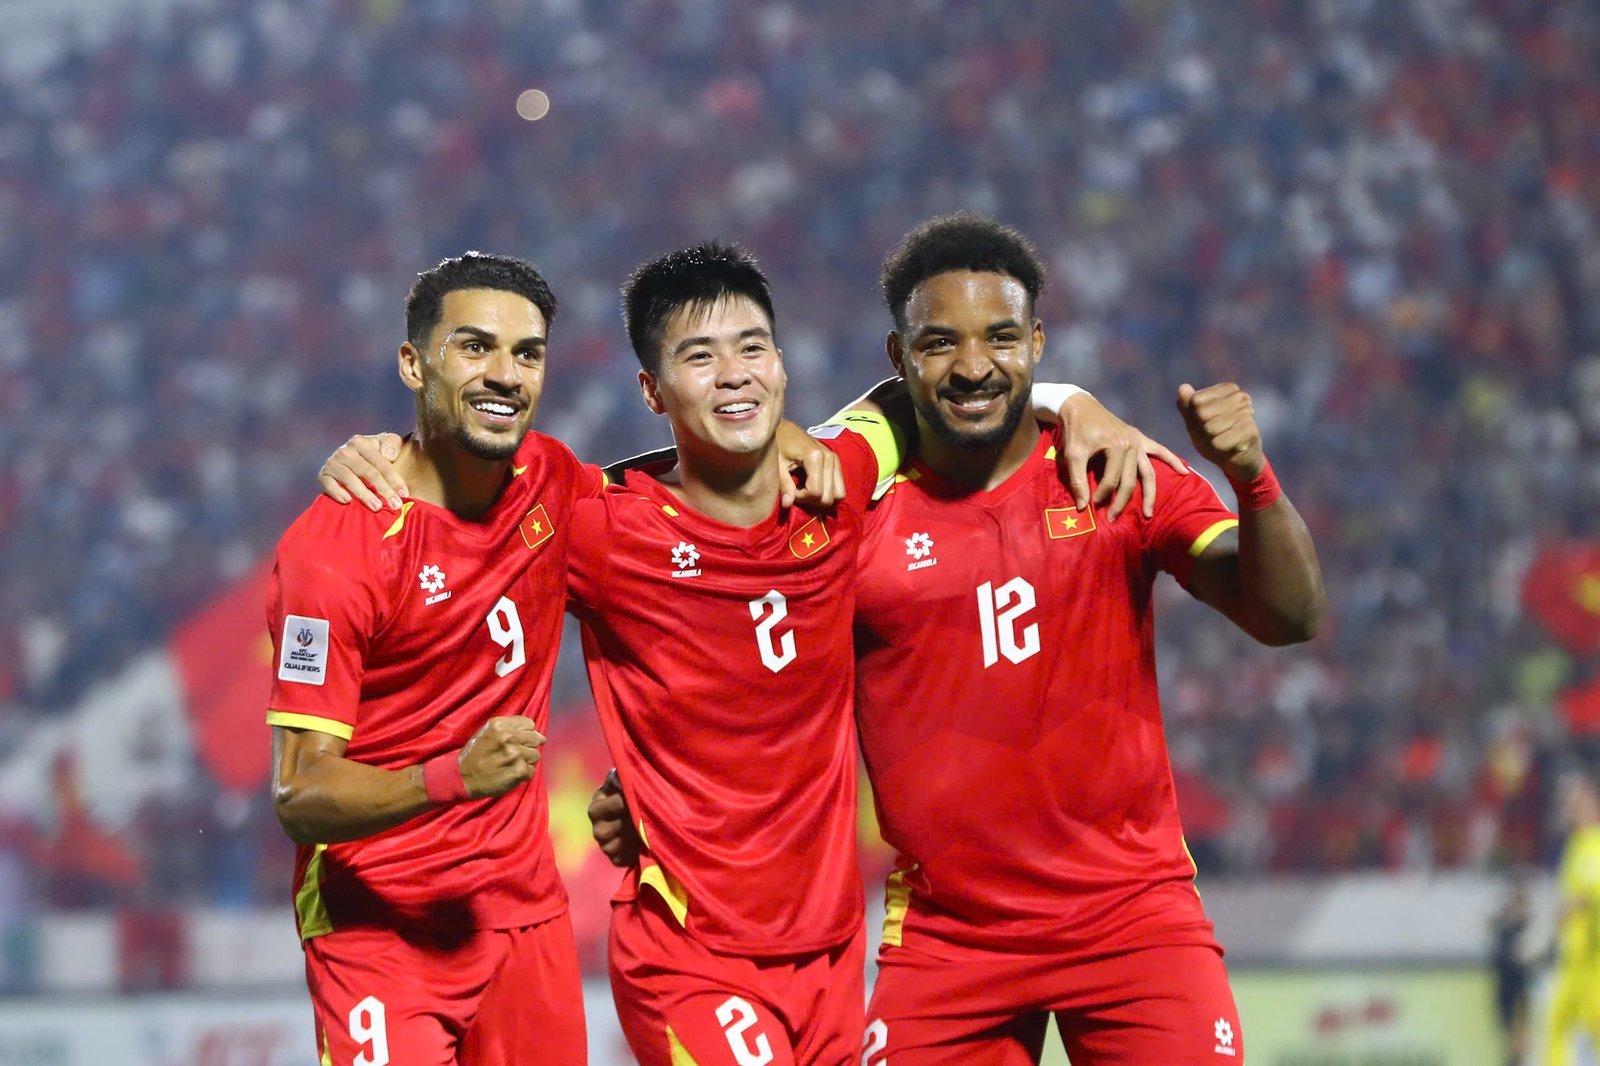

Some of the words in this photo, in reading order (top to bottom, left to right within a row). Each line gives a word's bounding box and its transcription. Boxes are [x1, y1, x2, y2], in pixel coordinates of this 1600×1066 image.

[486, 595, 526, 678] 9
[748, 589, 797, 673] 2
[976, 576, 1041, 669] 12
[284, 662, 321, 673] QUALIFIERS
[348, 995, 390, 1066] 9
[715, 995, 774, 1066] 2
